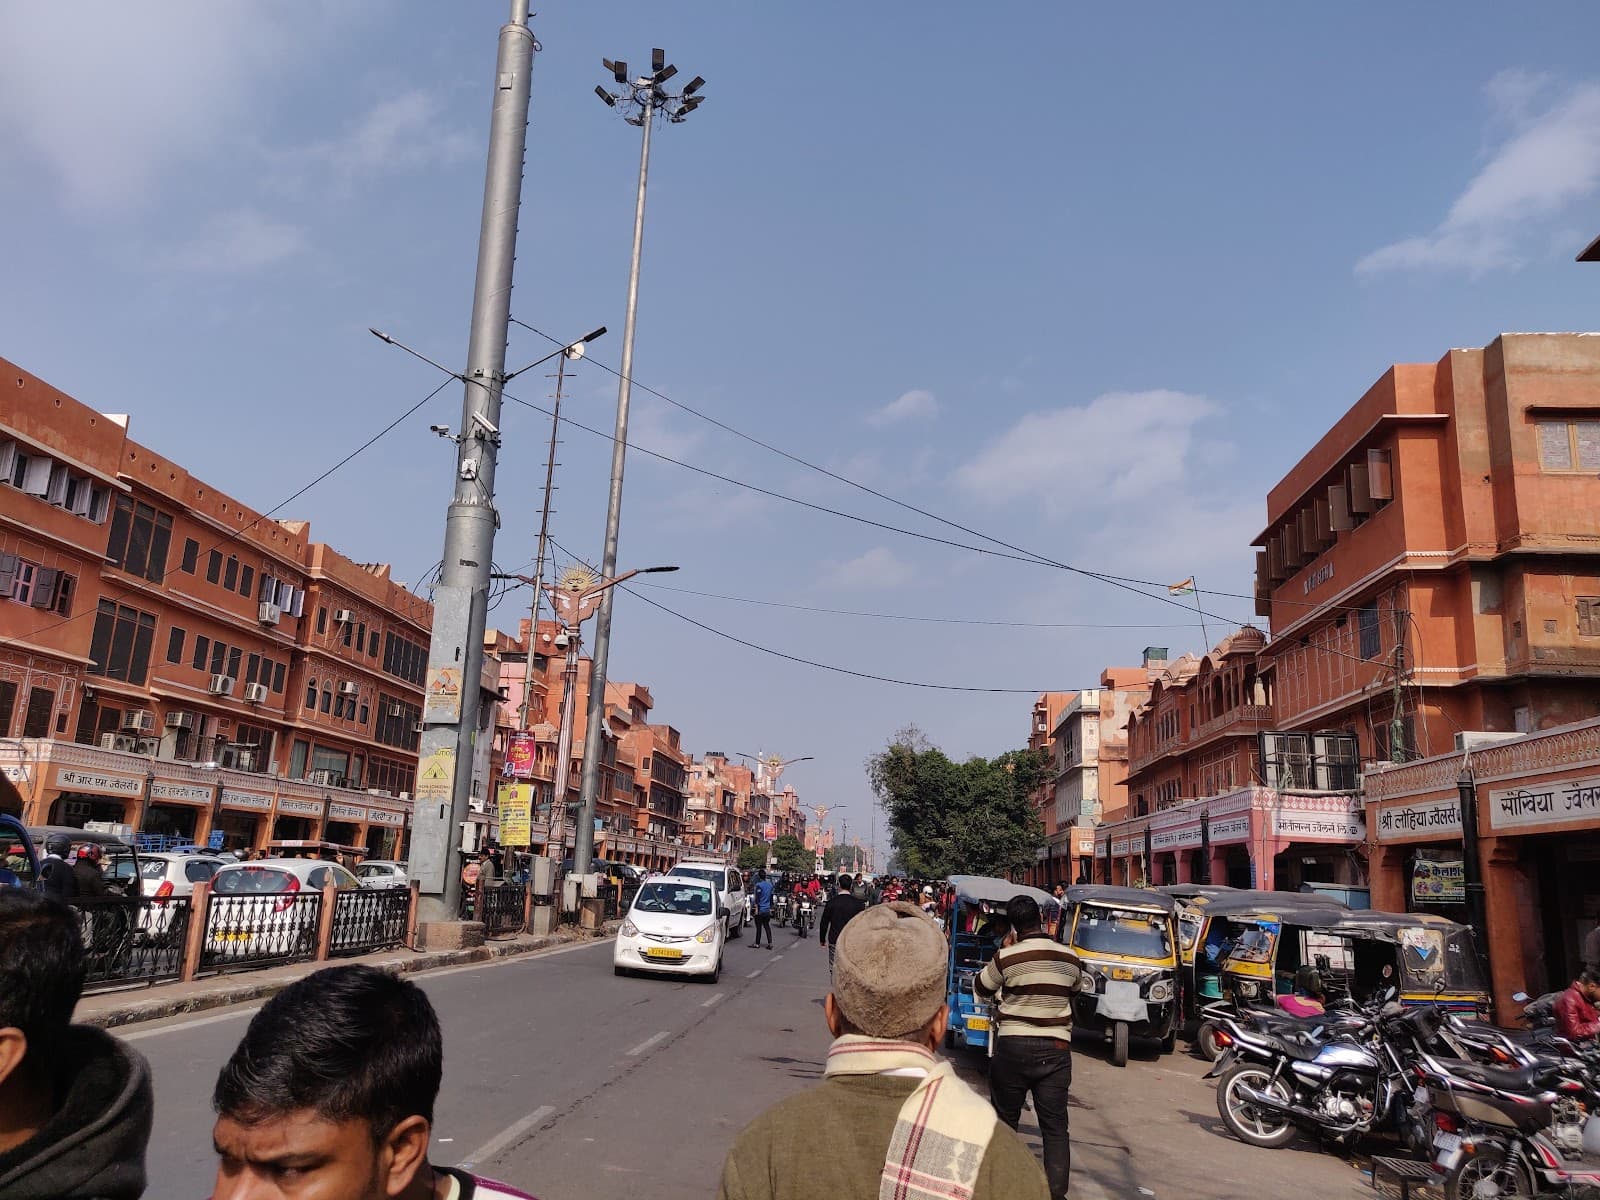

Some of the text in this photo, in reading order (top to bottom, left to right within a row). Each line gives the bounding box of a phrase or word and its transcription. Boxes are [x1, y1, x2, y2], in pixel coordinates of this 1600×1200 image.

[63, 772, 76, 783] श्री
[1381, 811, 1392, 830] श्री
[1394, 808, 1427, 830] लोहिया
